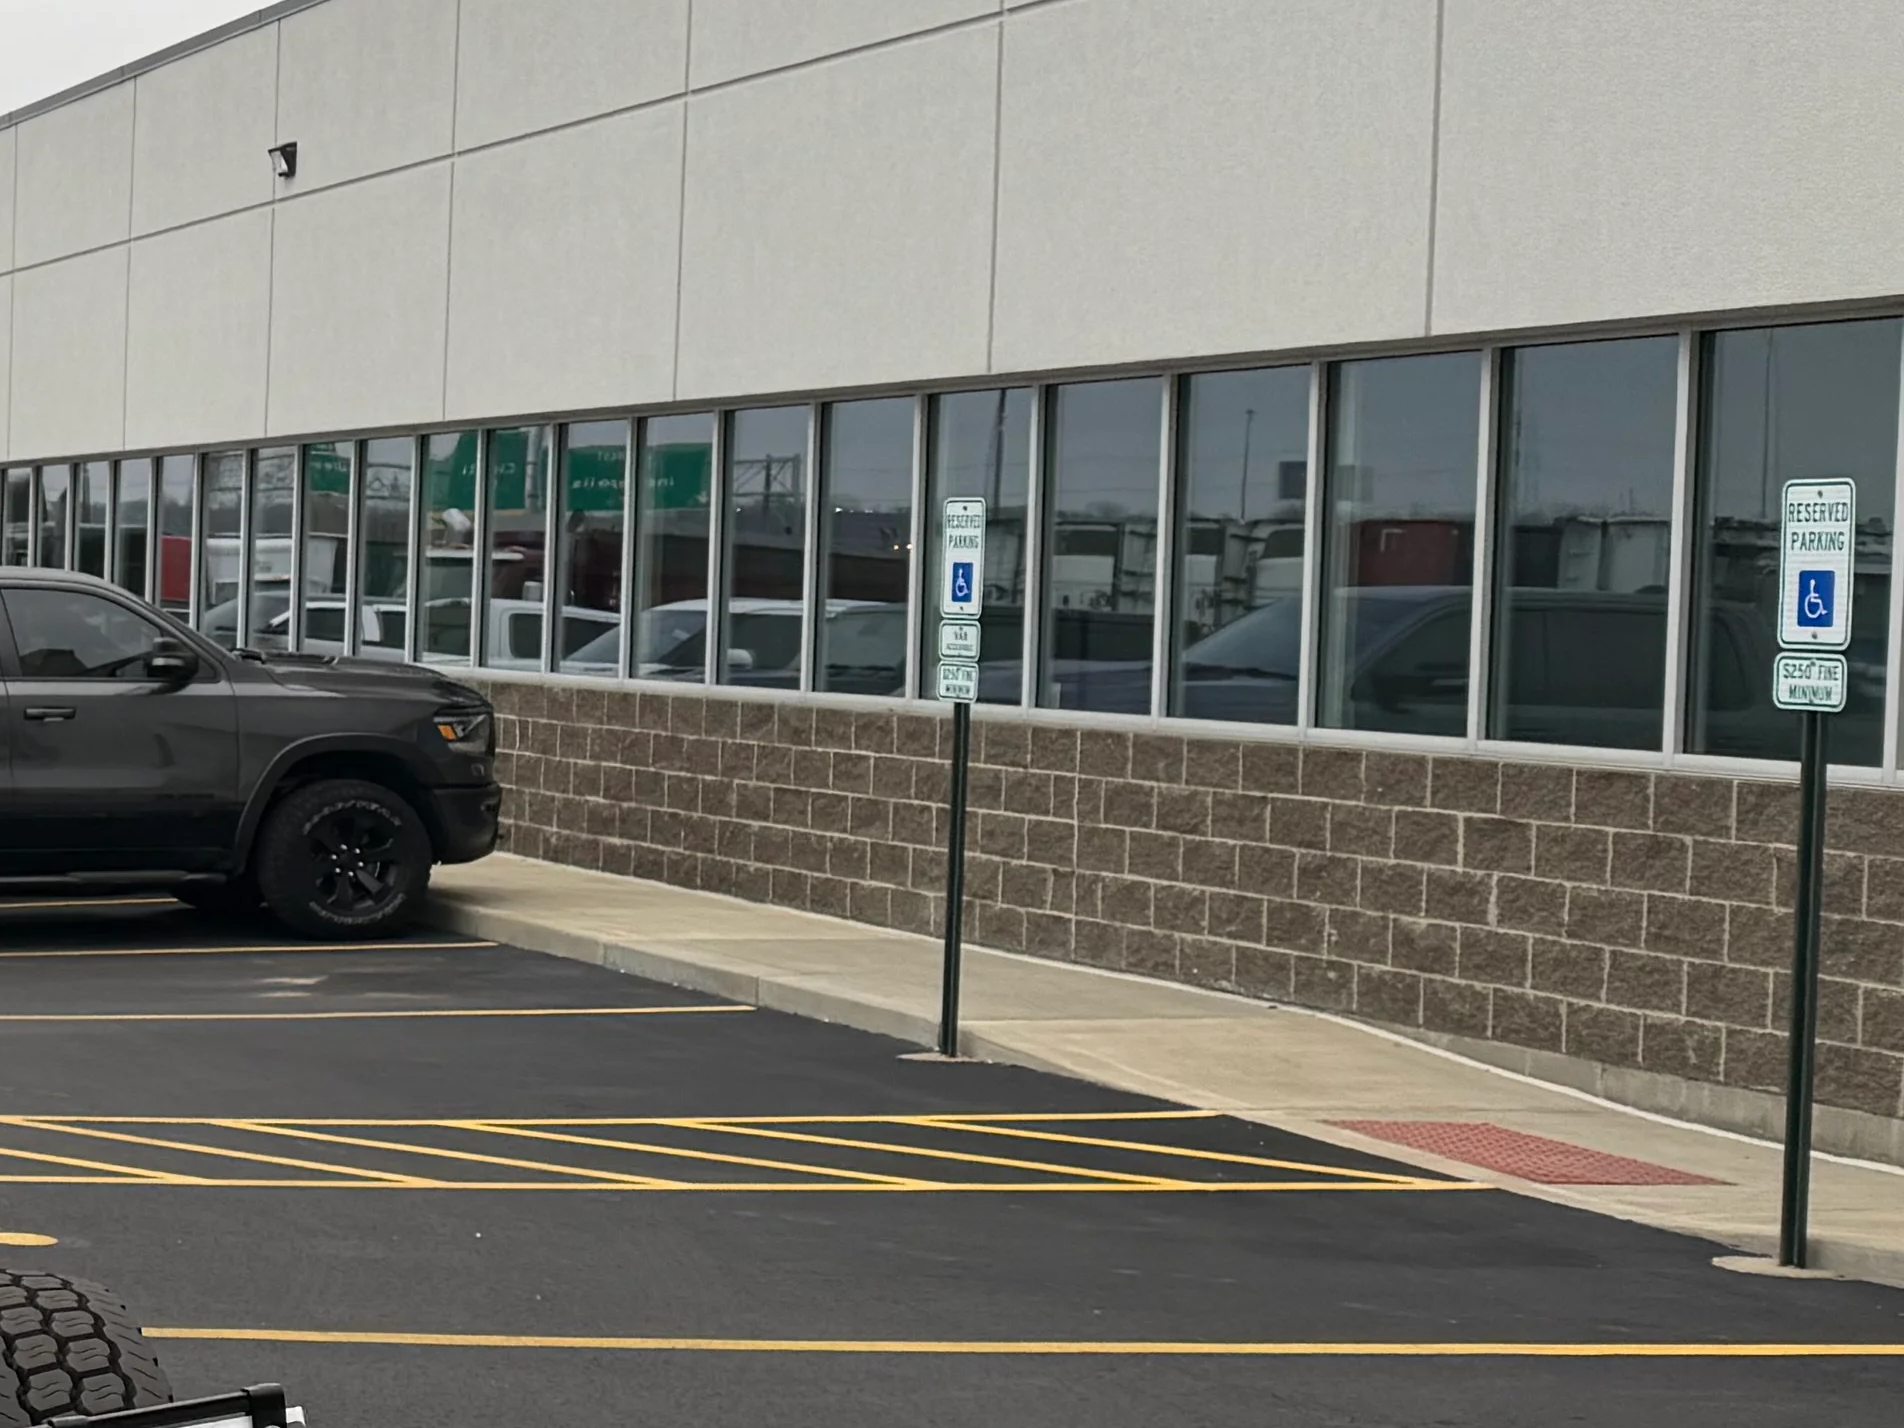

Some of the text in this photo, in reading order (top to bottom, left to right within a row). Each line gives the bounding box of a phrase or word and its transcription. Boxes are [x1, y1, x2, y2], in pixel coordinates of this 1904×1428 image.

[1788, 502, 1848, 522] RESERVED
[1790, 531, 1845, 551] PARKING
[1817, 665, 1840, 681] FINE
[1788, 683, 1833, 701] MINIMUM
